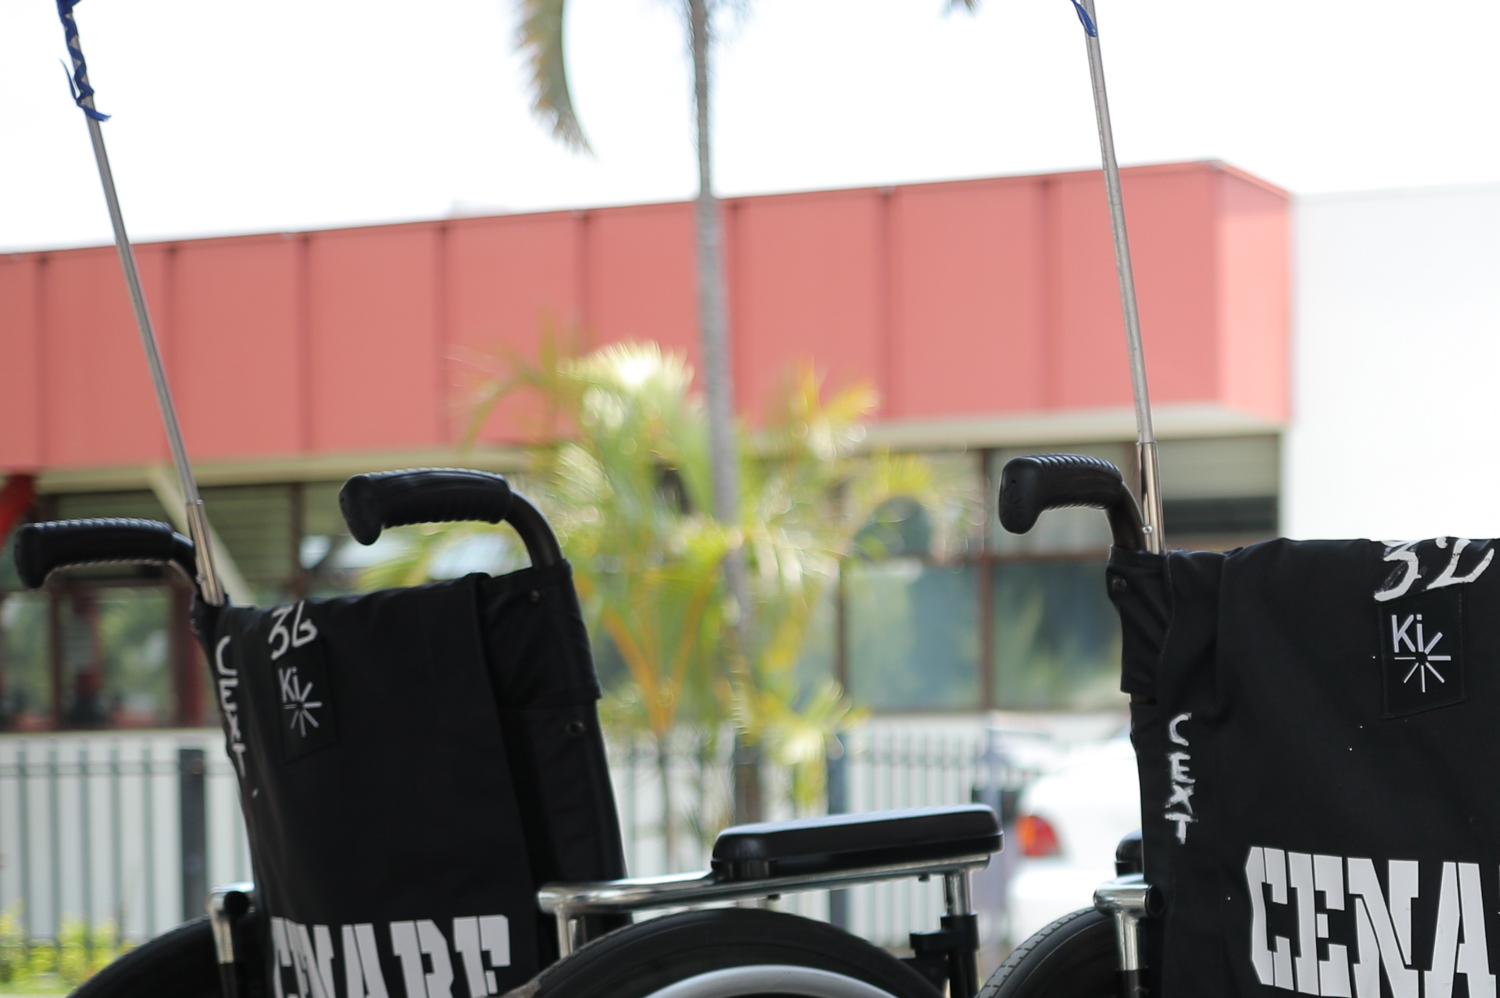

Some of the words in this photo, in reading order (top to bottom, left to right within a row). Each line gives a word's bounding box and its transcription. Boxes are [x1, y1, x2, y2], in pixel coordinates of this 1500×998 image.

[268, 601, 318, 660] 36
[1391, 614, 1424, 653] Ki
[278, 667, 300, 703] Ki
[1166, 712, 1197, 844] CEXT
